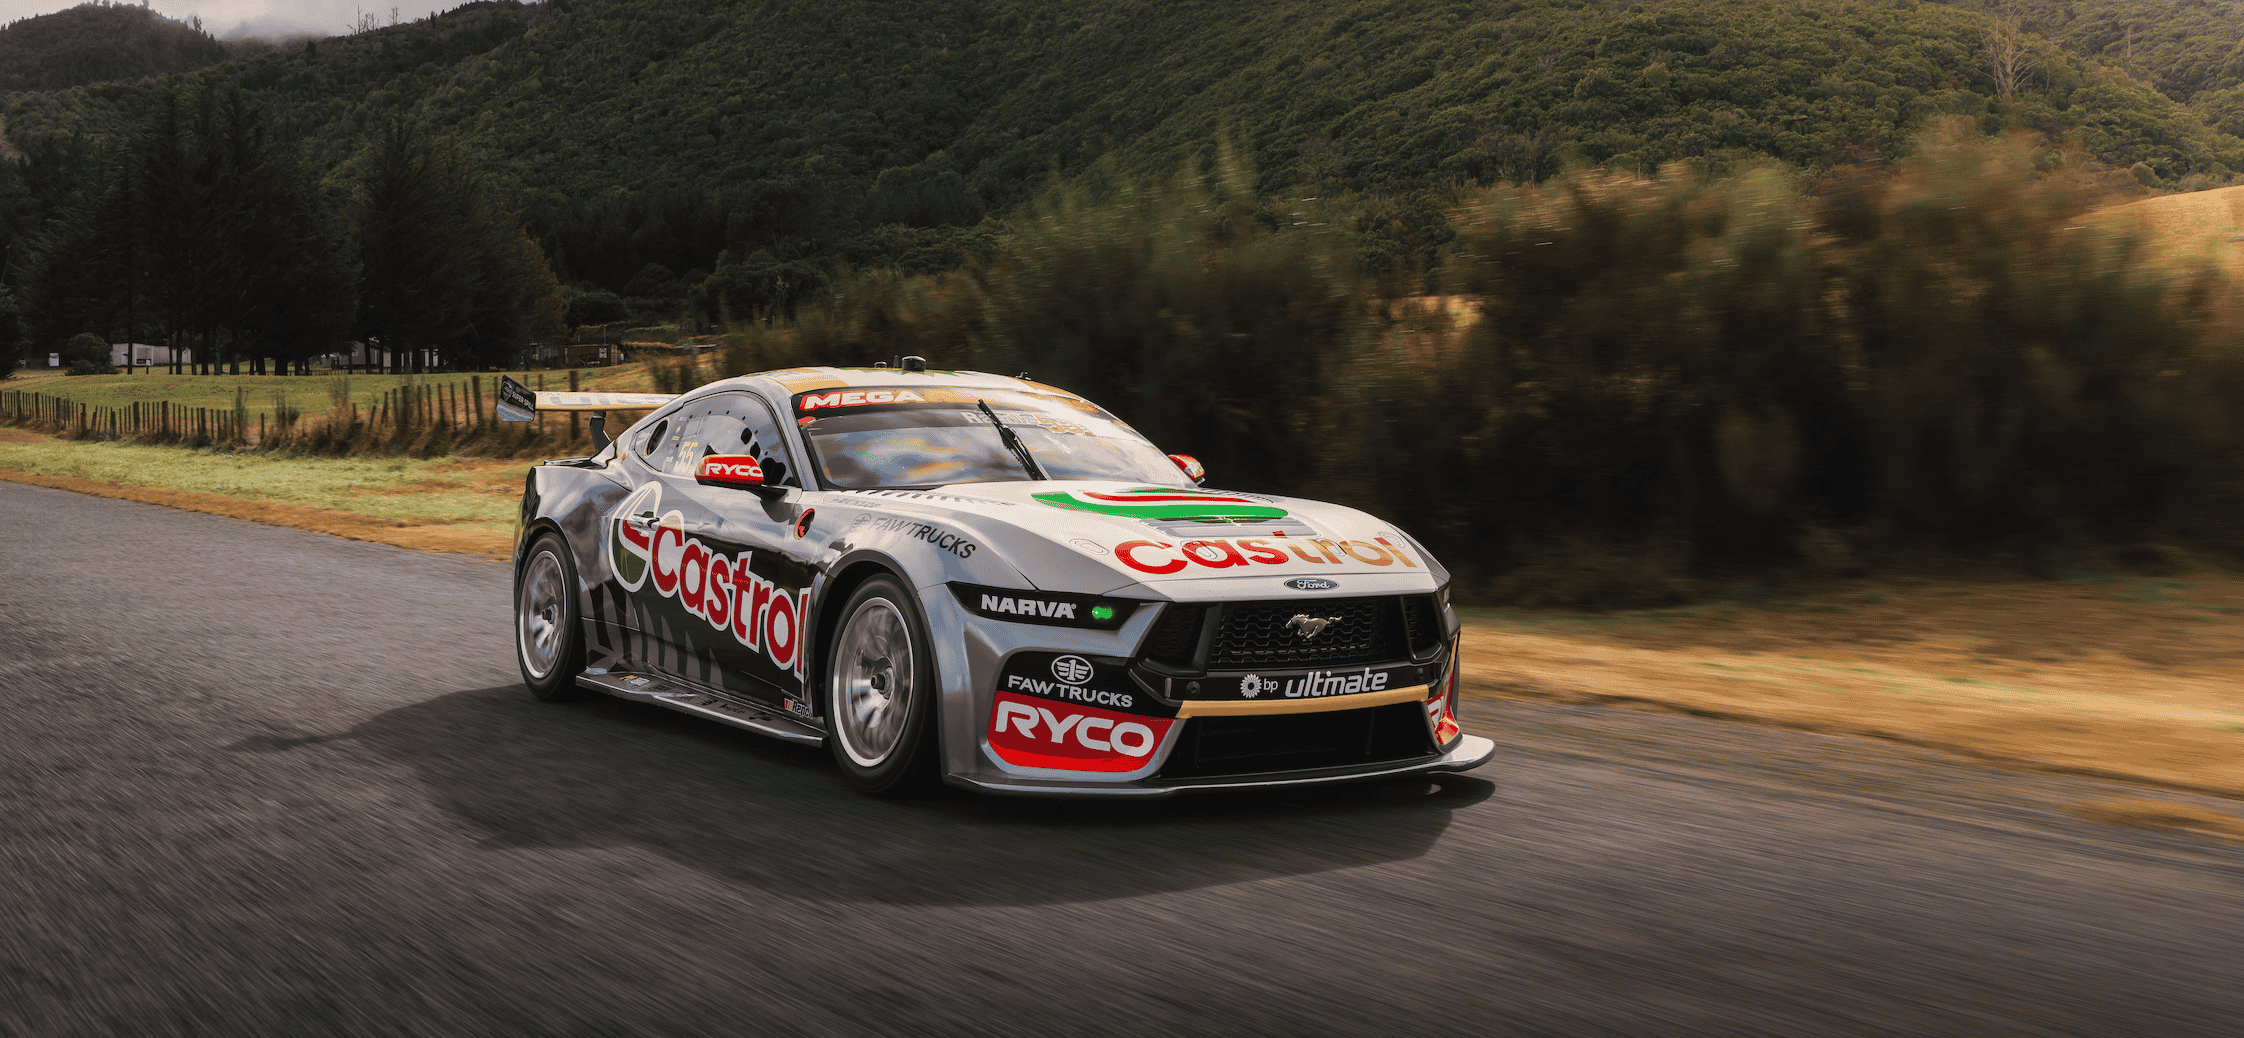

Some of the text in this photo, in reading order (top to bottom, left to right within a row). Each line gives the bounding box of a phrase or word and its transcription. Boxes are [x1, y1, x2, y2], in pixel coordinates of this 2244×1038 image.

[804, 390, 926, 409] MEGA
[705, 463, 764, 478] RYCO
[872, 517, 976, 559] FAW TRUCKS
[652, 512, 810, 678] Castrol
[1297, 579, 1331, 590] Ford
[981, 594, 1076, 619] NARVA
[1008, 675, 1133, 708] FAW TRUCKS
[1263, 667, 1388, 698] bp ultimate
[995, 701, 1155, 758] RYCO
